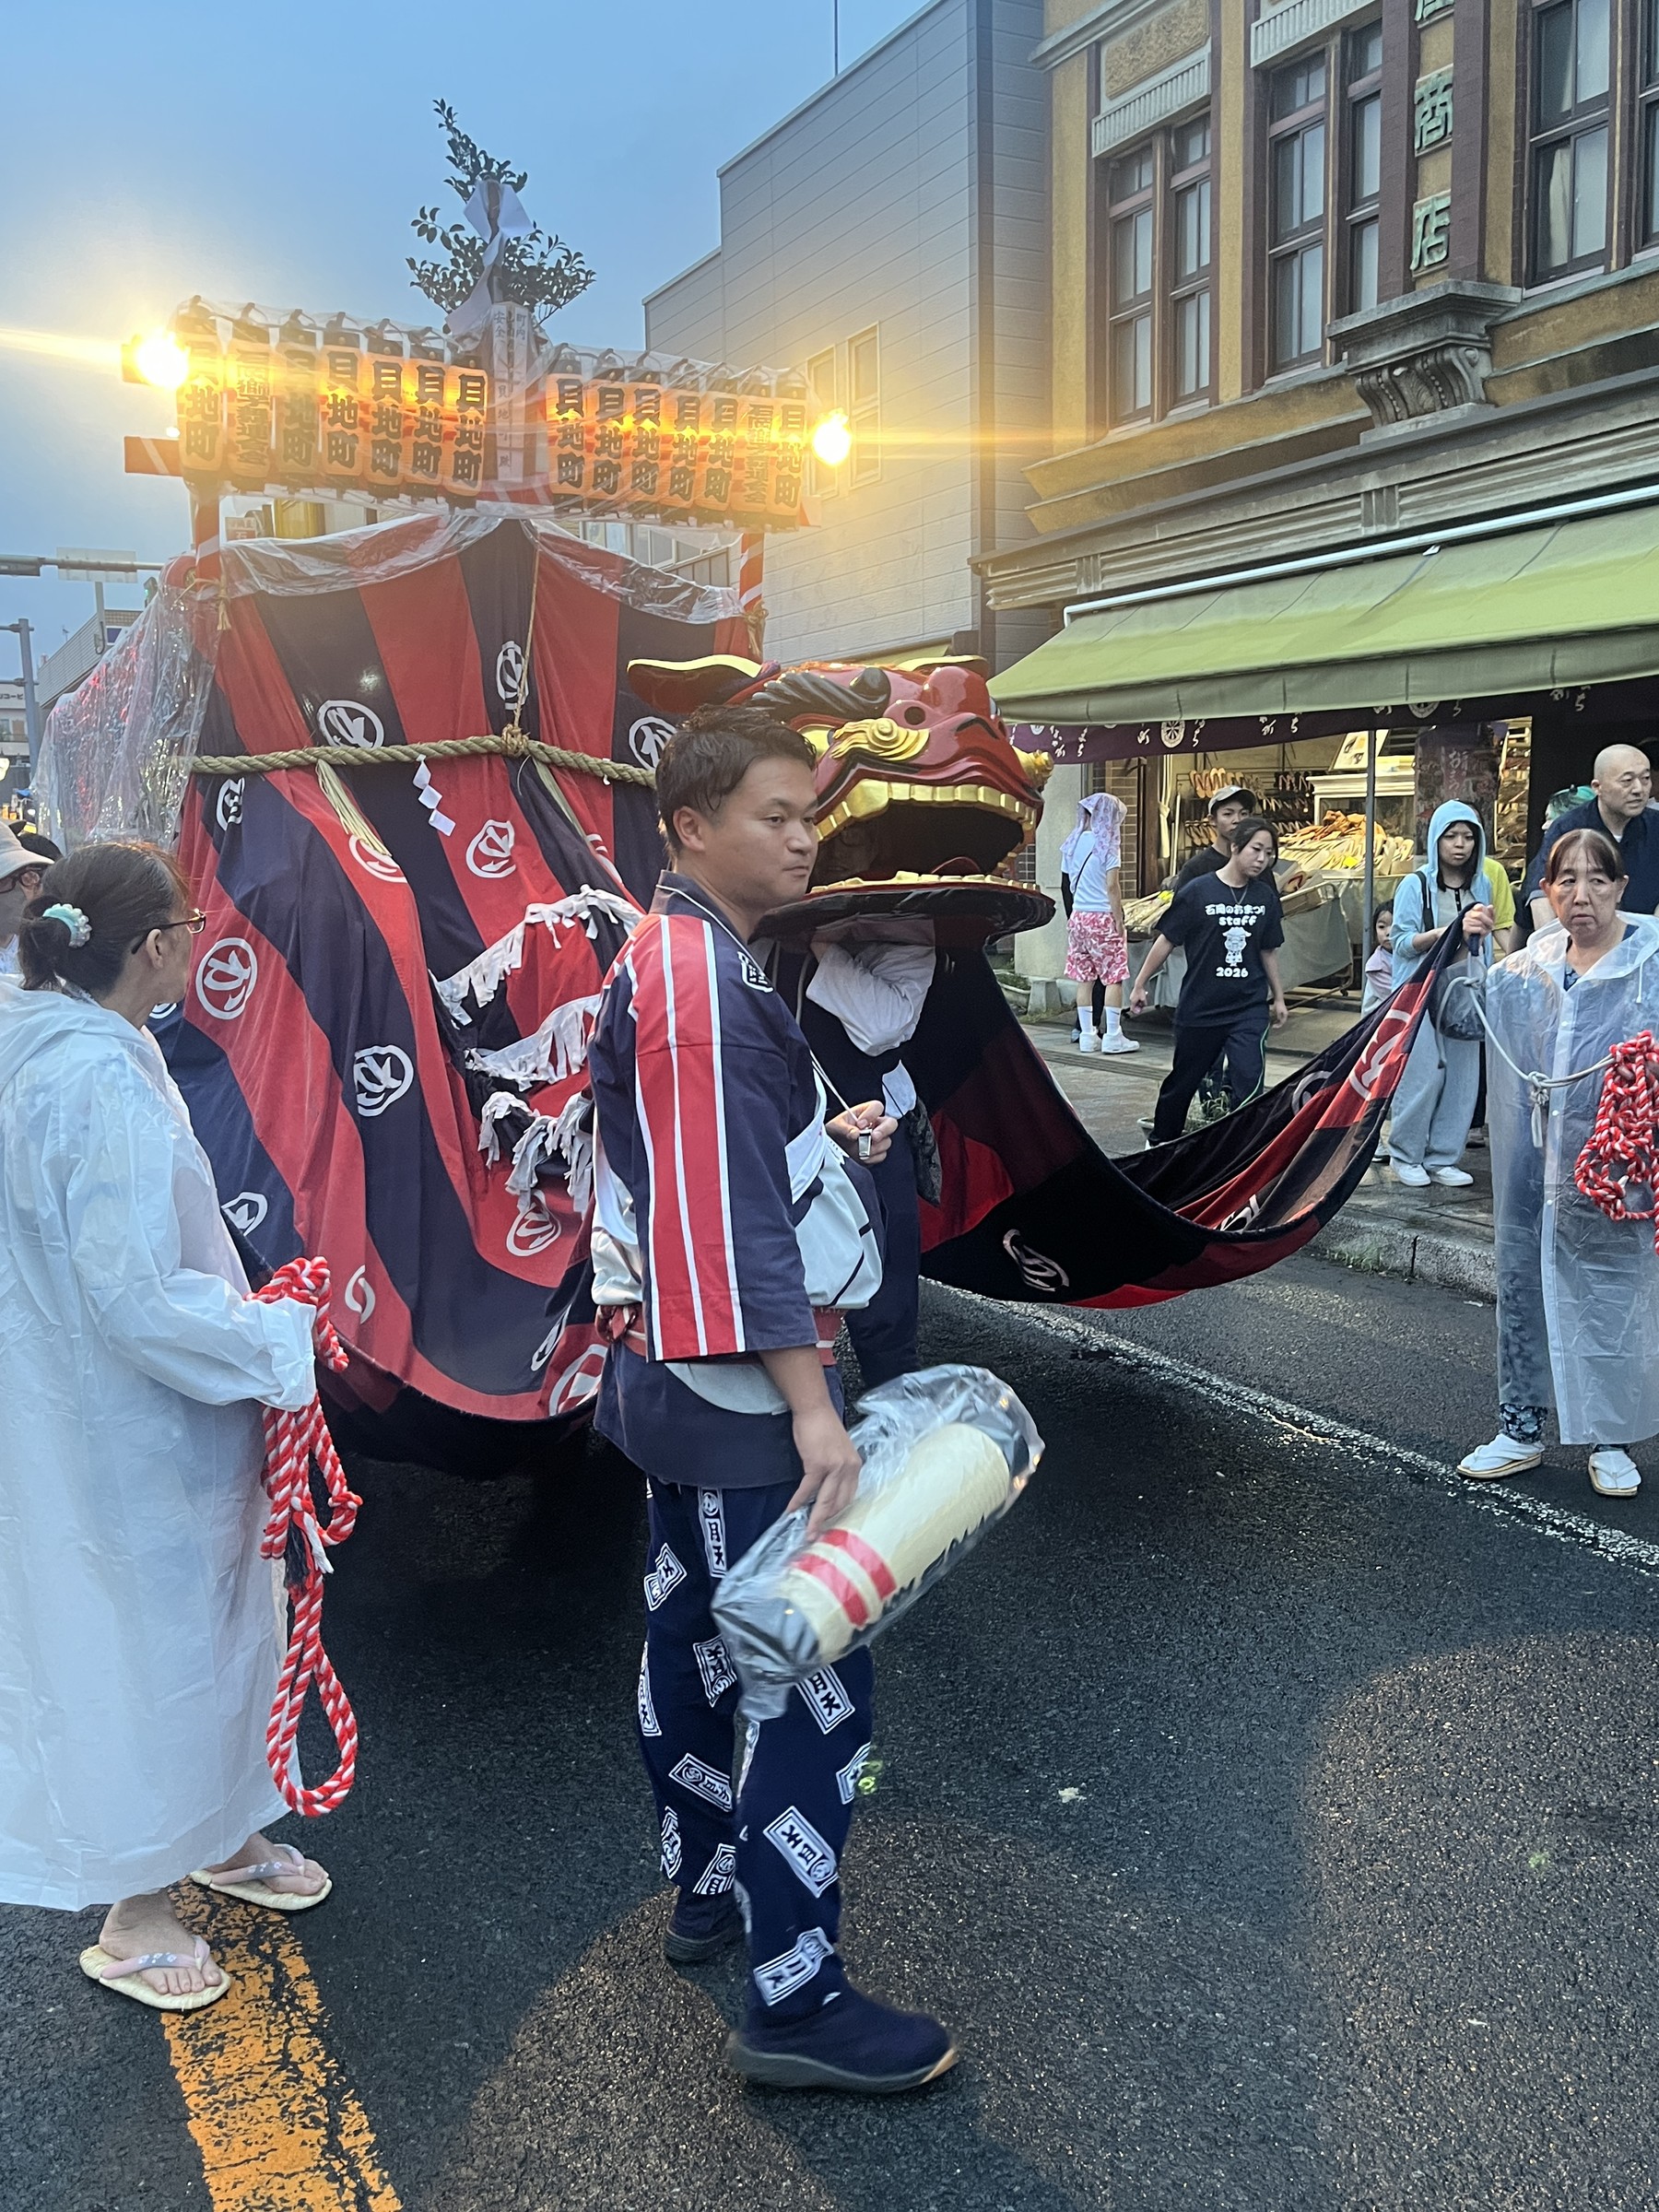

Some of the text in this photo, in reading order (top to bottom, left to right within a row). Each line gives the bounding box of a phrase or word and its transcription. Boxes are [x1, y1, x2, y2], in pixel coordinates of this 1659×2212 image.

[1410, 0, 1454, 271] 商店
[494, 311, 506, 338] 安全
[327, 350, 359, 469] 貝地町
[371, 360, 404, 479] 貝地町
[412, 364, 446, 479] 貝地町
[453, 373, 487, 488] 貝地町
[555, 378, 585, 489] 貝地町
[593, 386, 625, 496] 貝地町
[631, 388, 662, 496] 貝地町
[668, 395, 700, 502] 貝地町
[704, 397, 739, 504] 貝地町
[1205, 903, 1265, 915] 石岡のおまつり
[1218, 915, 1257, 925] staff
[1216, 967, 1249, 978] 2026
